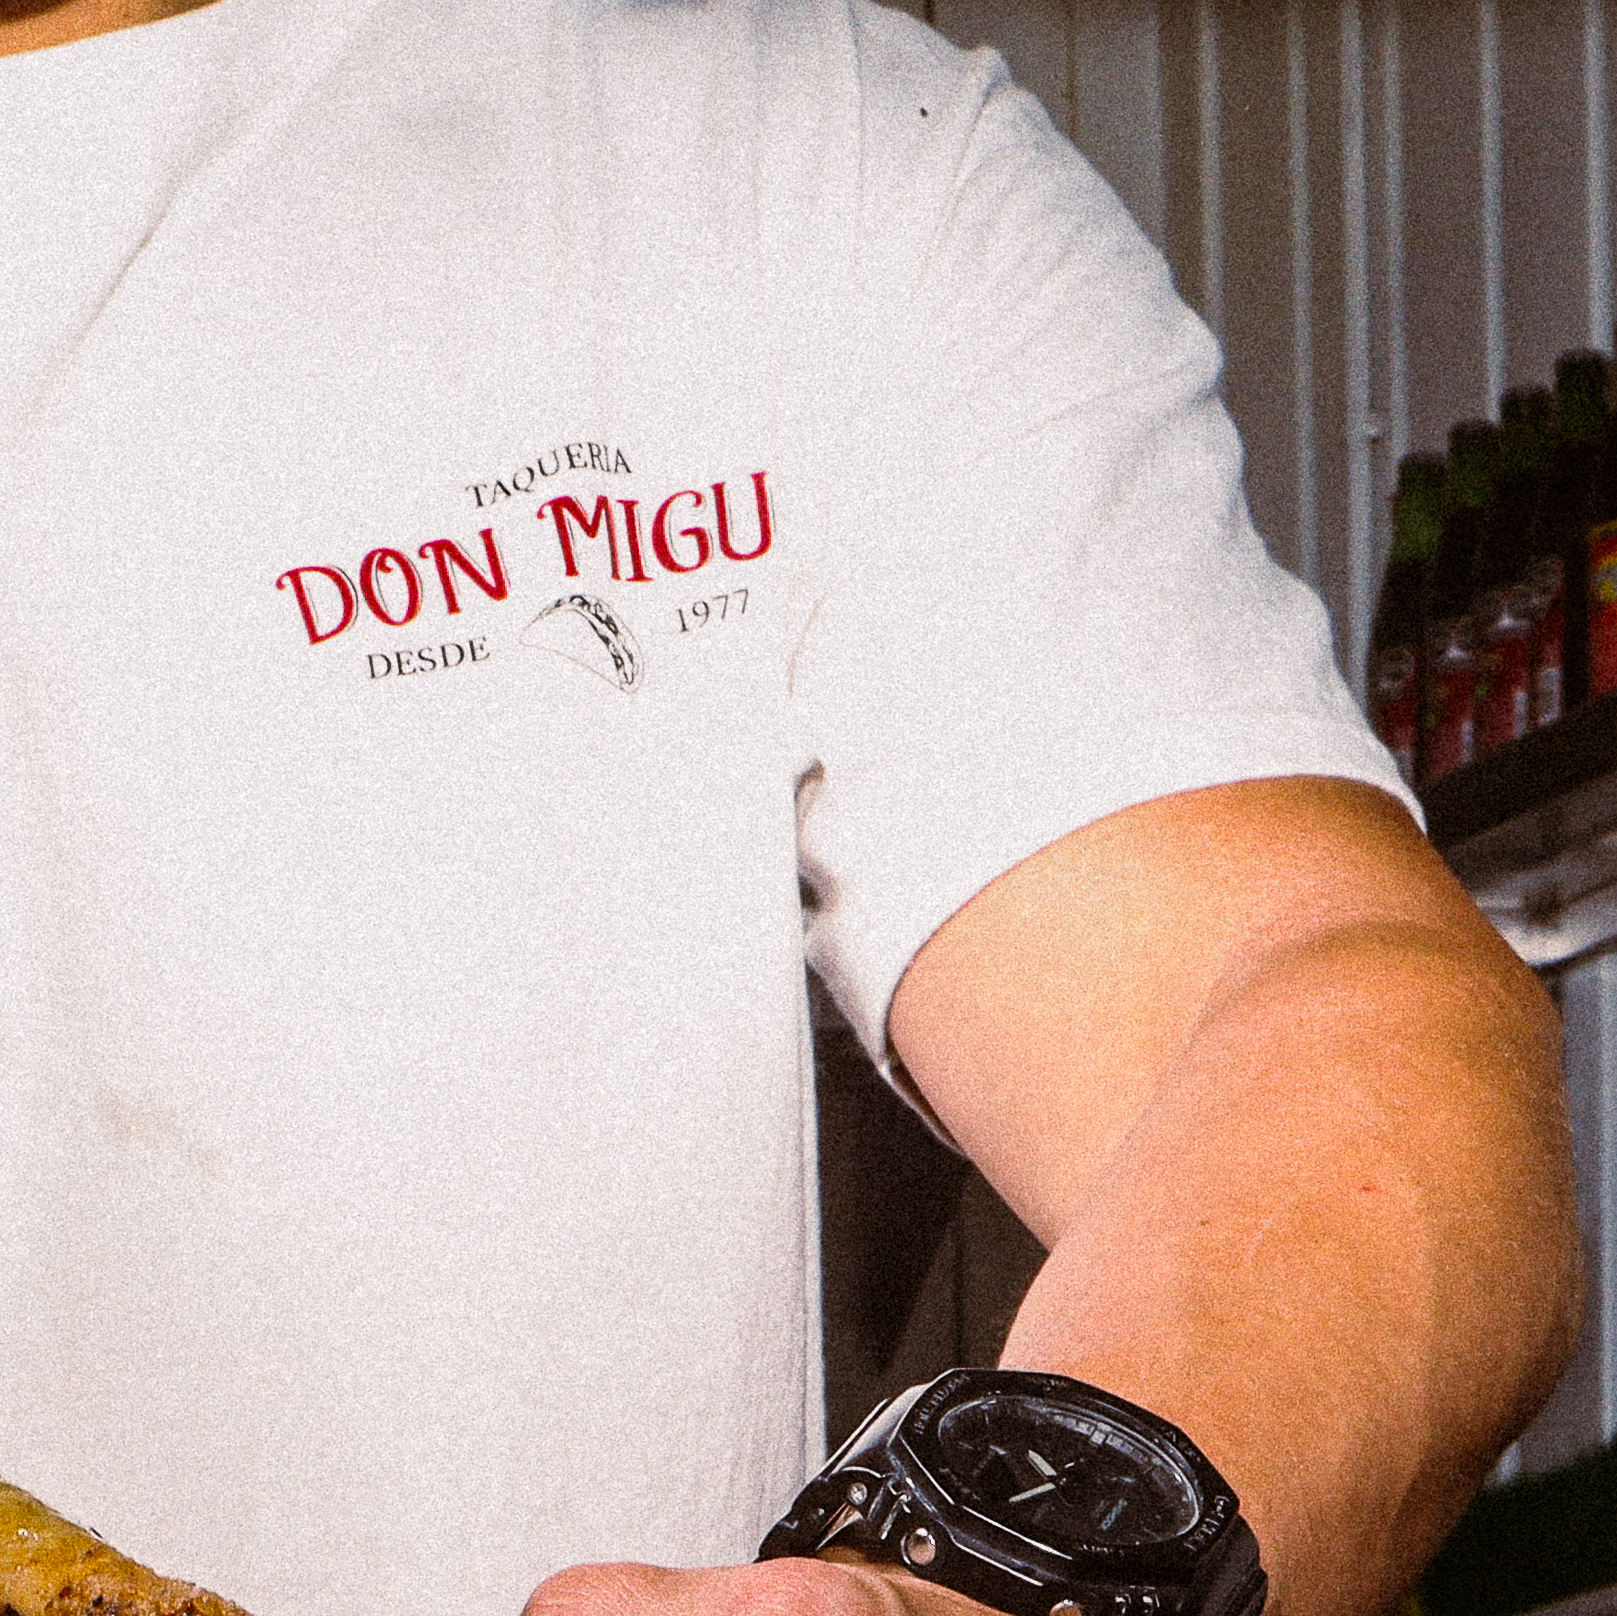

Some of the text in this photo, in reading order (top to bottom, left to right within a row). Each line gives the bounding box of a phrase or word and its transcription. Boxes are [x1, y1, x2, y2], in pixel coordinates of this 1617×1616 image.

[465, 441, 633, 509] TAQUERIA
[275, 471, 777, 645] DON MIGU
[366, 588, 751, 680] DESDE 1977
